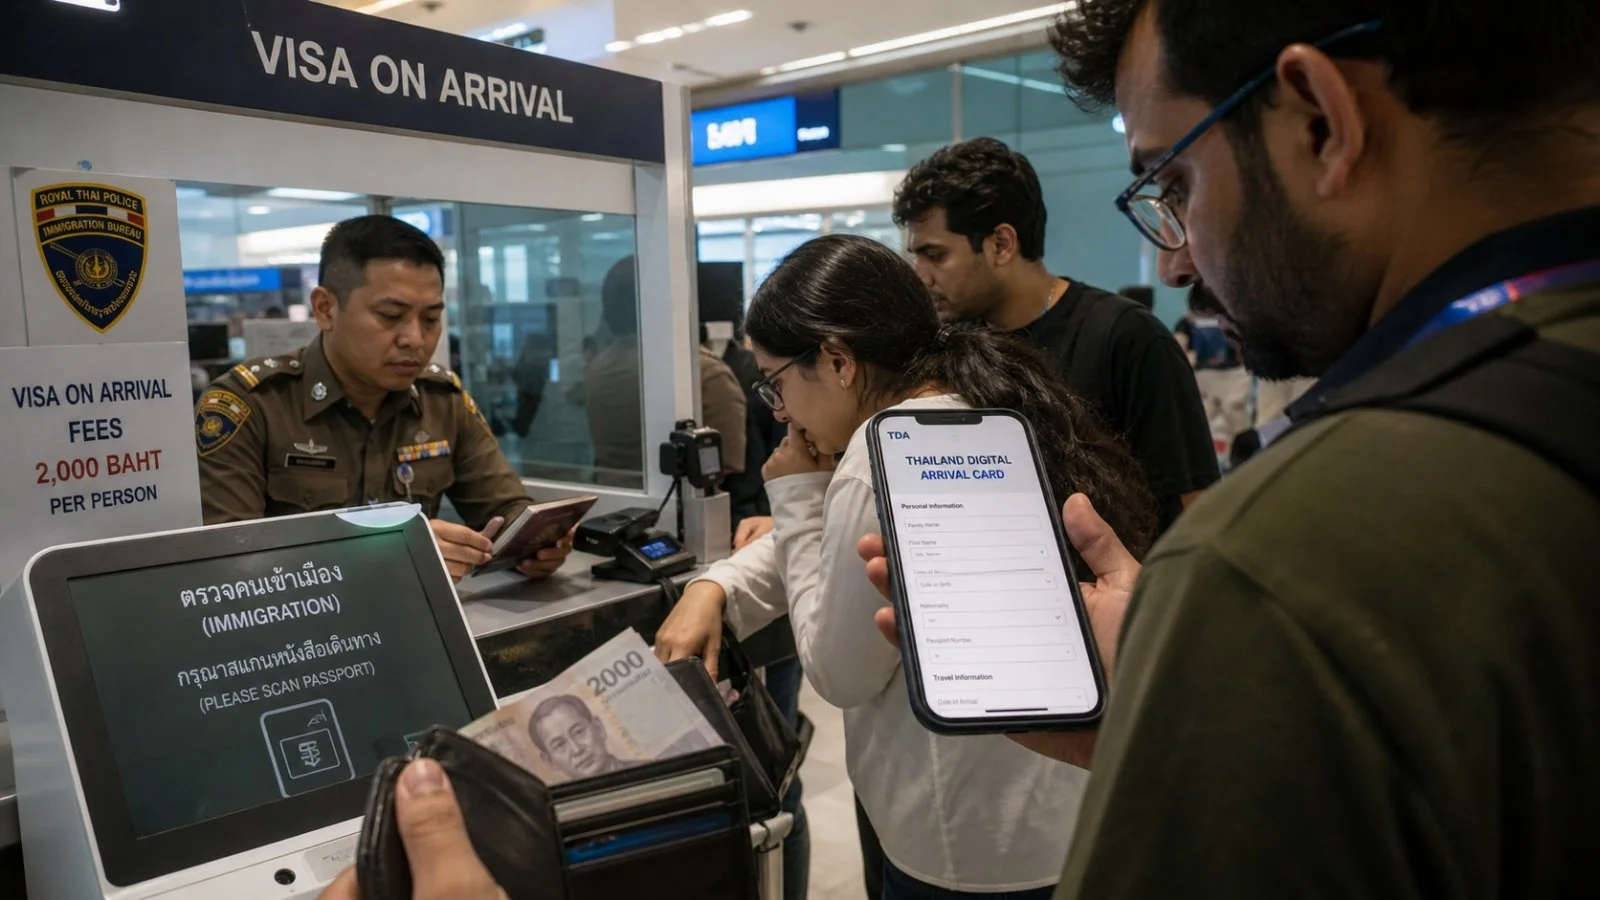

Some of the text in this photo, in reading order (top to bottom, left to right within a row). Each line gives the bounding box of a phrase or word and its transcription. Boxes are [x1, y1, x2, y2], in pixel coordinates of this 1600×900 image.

[250, 30, 573, 124] VISA ON ARRIVAL
[40, 190, 138, 210] ROYAL THAI POLICE
[43, 220, 142, 240] IMMIGRATION BUREAU
[12, 378, 172, 409] VISA ON ARRIVAL
[68, 417, 123, 443] FEES
[887, 431, 911, 440] TDA
[35, 449, 162, 487] 2,000 BAHT
[905, 455, 1012, 466] THAILAND DIGITAL
[920, 469, 1005, 480] ARRIVAL CARD
[50, 484, 158, 515] PER PERSON
[180, 561, 343, 608] ตรวจคนเข้าเมือง
[202, 594, 341, 638] (IMMIGRATION)
[177, 631, 381, 689] กรุณาสแกนหนังสือเดินทาง
[586, 650, 644, 697] 2000
[199, 661, 375, 714] (PLEASE SCAN PASSPORT)
